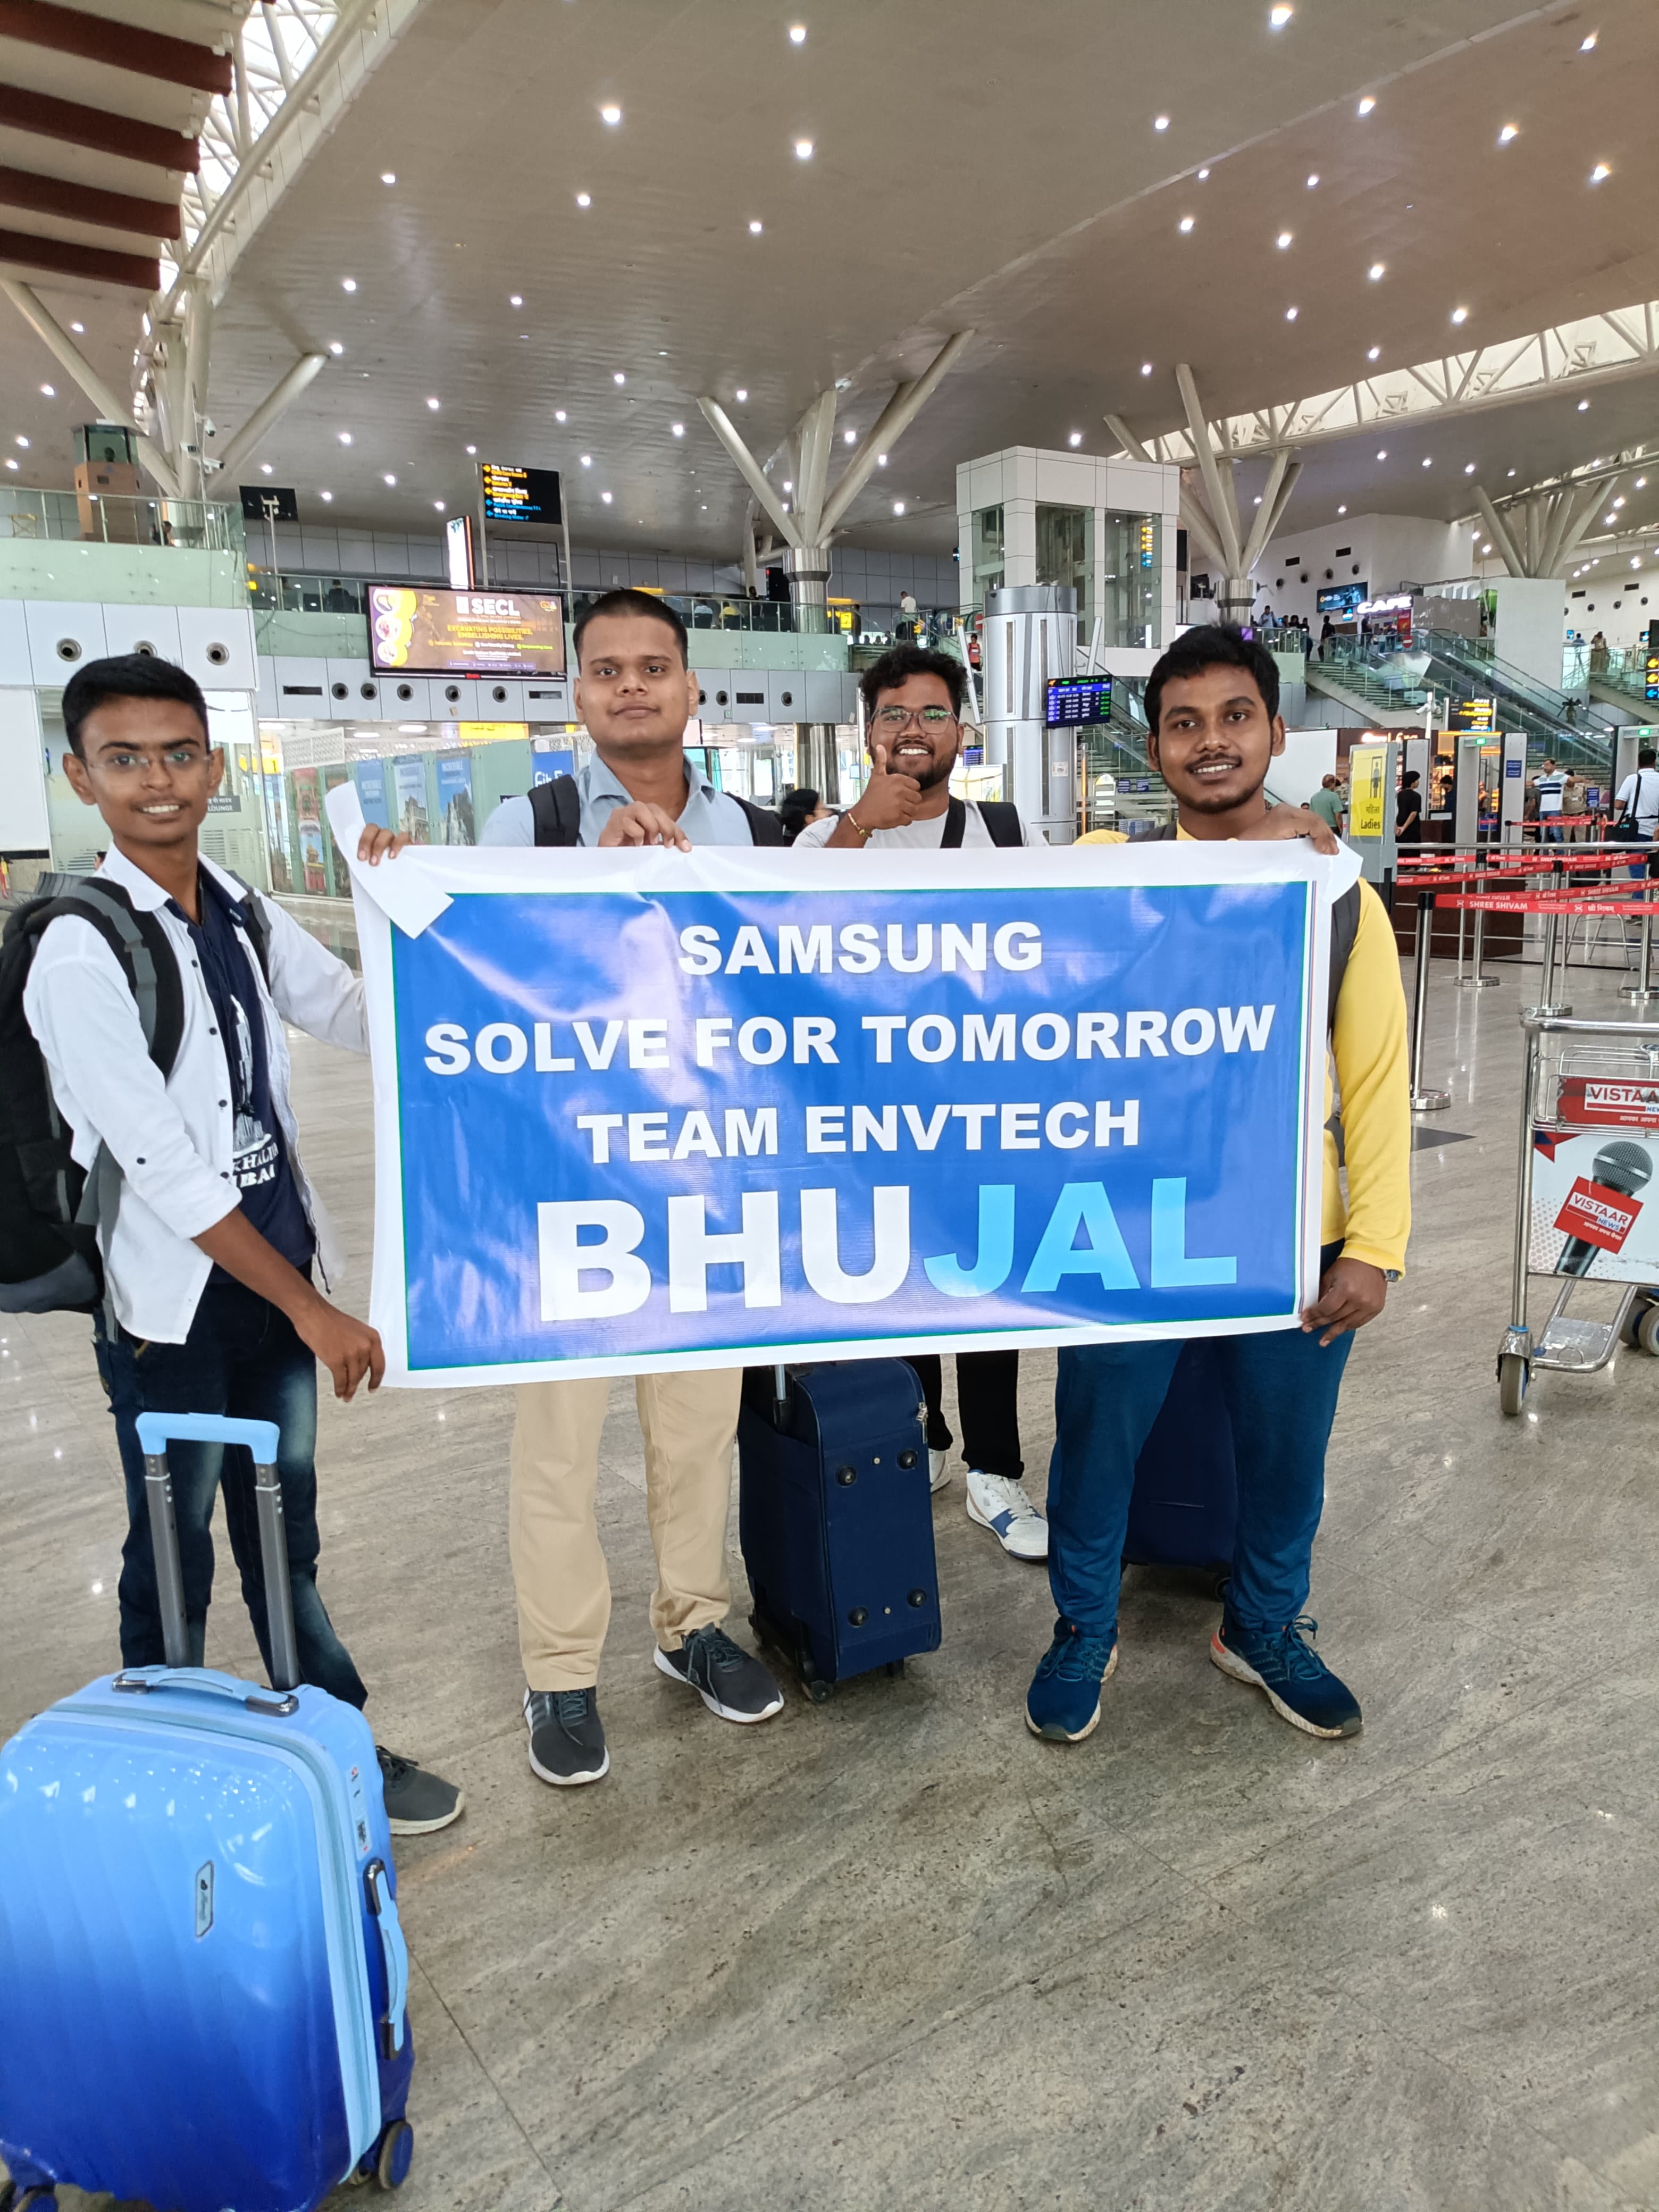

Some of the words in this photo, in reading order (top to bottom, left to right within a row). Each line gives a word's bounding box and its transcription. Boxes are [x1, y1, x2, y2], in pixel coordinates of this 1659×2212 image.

[471, 597, 521, 616] SECL
[1361, 819, 1380, 830] Ladies
[1496, 901, 1528, 910] SHIVAM
[678, 920, 1043, 975] SAMSUNG
[424, 1018, 671, 1075] SOLVE
[696, 1016, 839, 1067] FOR
[861, 1004, 1276, 1063] TOMORROW
[577, 1107, 778, 1164] TEAM
[806, 1100, 1140, 1154] ENVTECH
[238, 1164, 275, 1188] BAI
[1574, 1194, 1628, 1225] VISTAAR
[1598, 1218, 1620, 1230] NEWS
